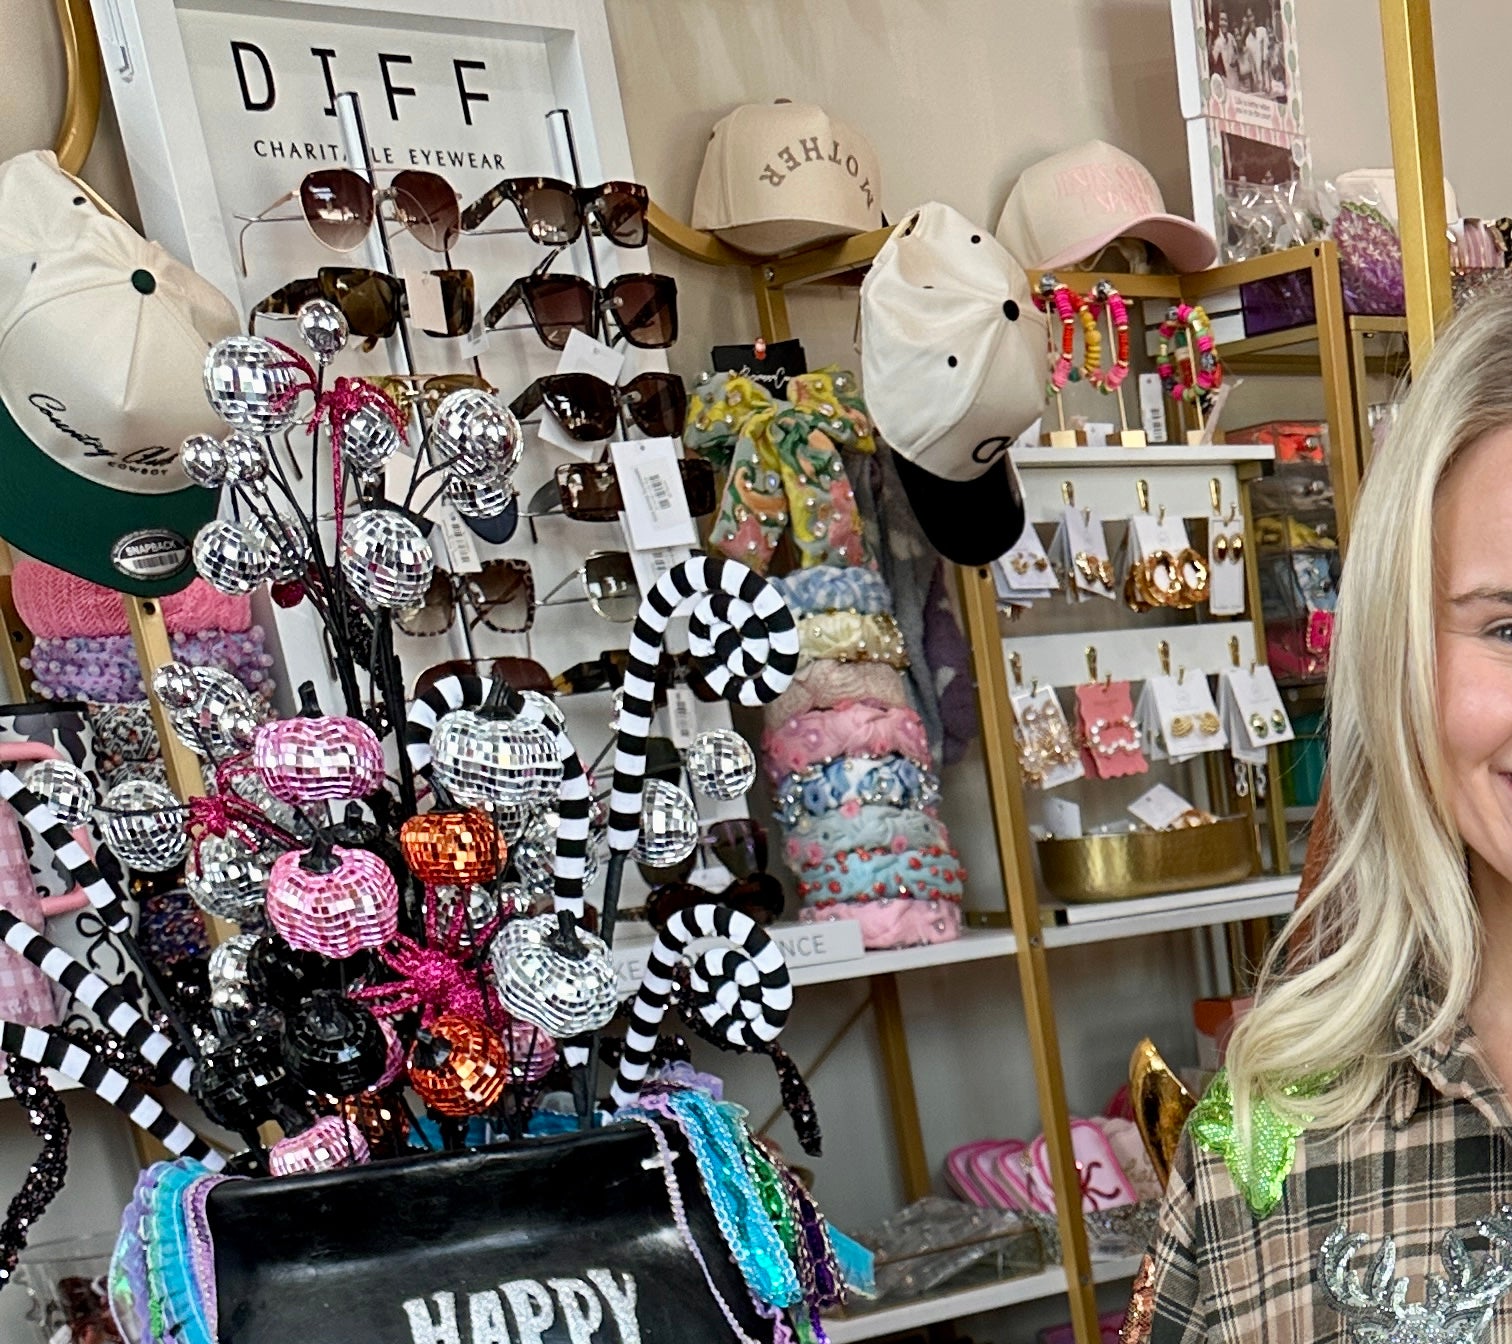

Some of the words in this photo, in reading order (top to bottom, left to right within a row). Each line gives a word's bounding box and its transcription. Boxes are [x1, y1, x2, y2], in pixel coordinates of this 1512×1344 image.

[230, 40, 489, 126] DIFF
[254, 140, 394, 164] CHARITLE
[410, 149, 506, 170] EYEWEAR
[759, 136, 874, 210] MOTHER
[28, 393, 118, 457] Country
[107, 461, 168, 476] COWBOY
[125, 540, 177, 556] SNAPBACK
